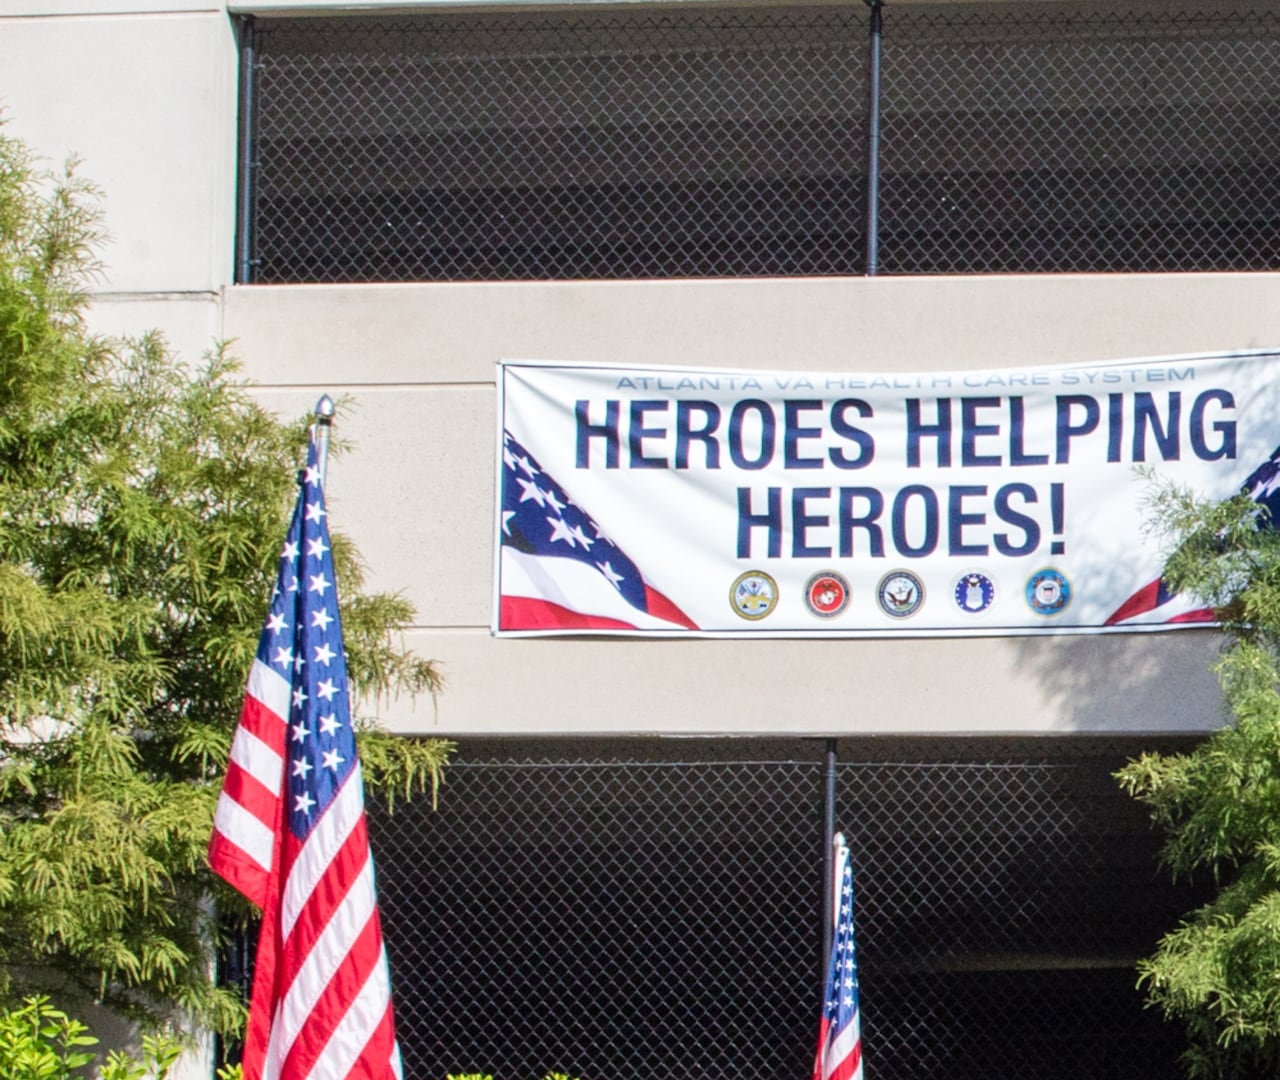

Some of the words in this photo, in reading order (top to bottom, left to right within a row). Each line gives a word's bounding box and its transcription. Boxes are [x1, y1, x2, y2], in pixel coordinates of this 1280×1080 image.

[616, 376, 764, 391] ATLANTA
[774, 375, 815, 390] VA
[825, 375, 952, 389] HEALTH
[963, 371, 1050, 388] CARE
[1060, 367, 1196, 386] SYSTEM
[574, 398, 876, 471] HEROES
[904, 388, 1238, 469] HELPING
[735, 481, 1066, 560] HEROES!
